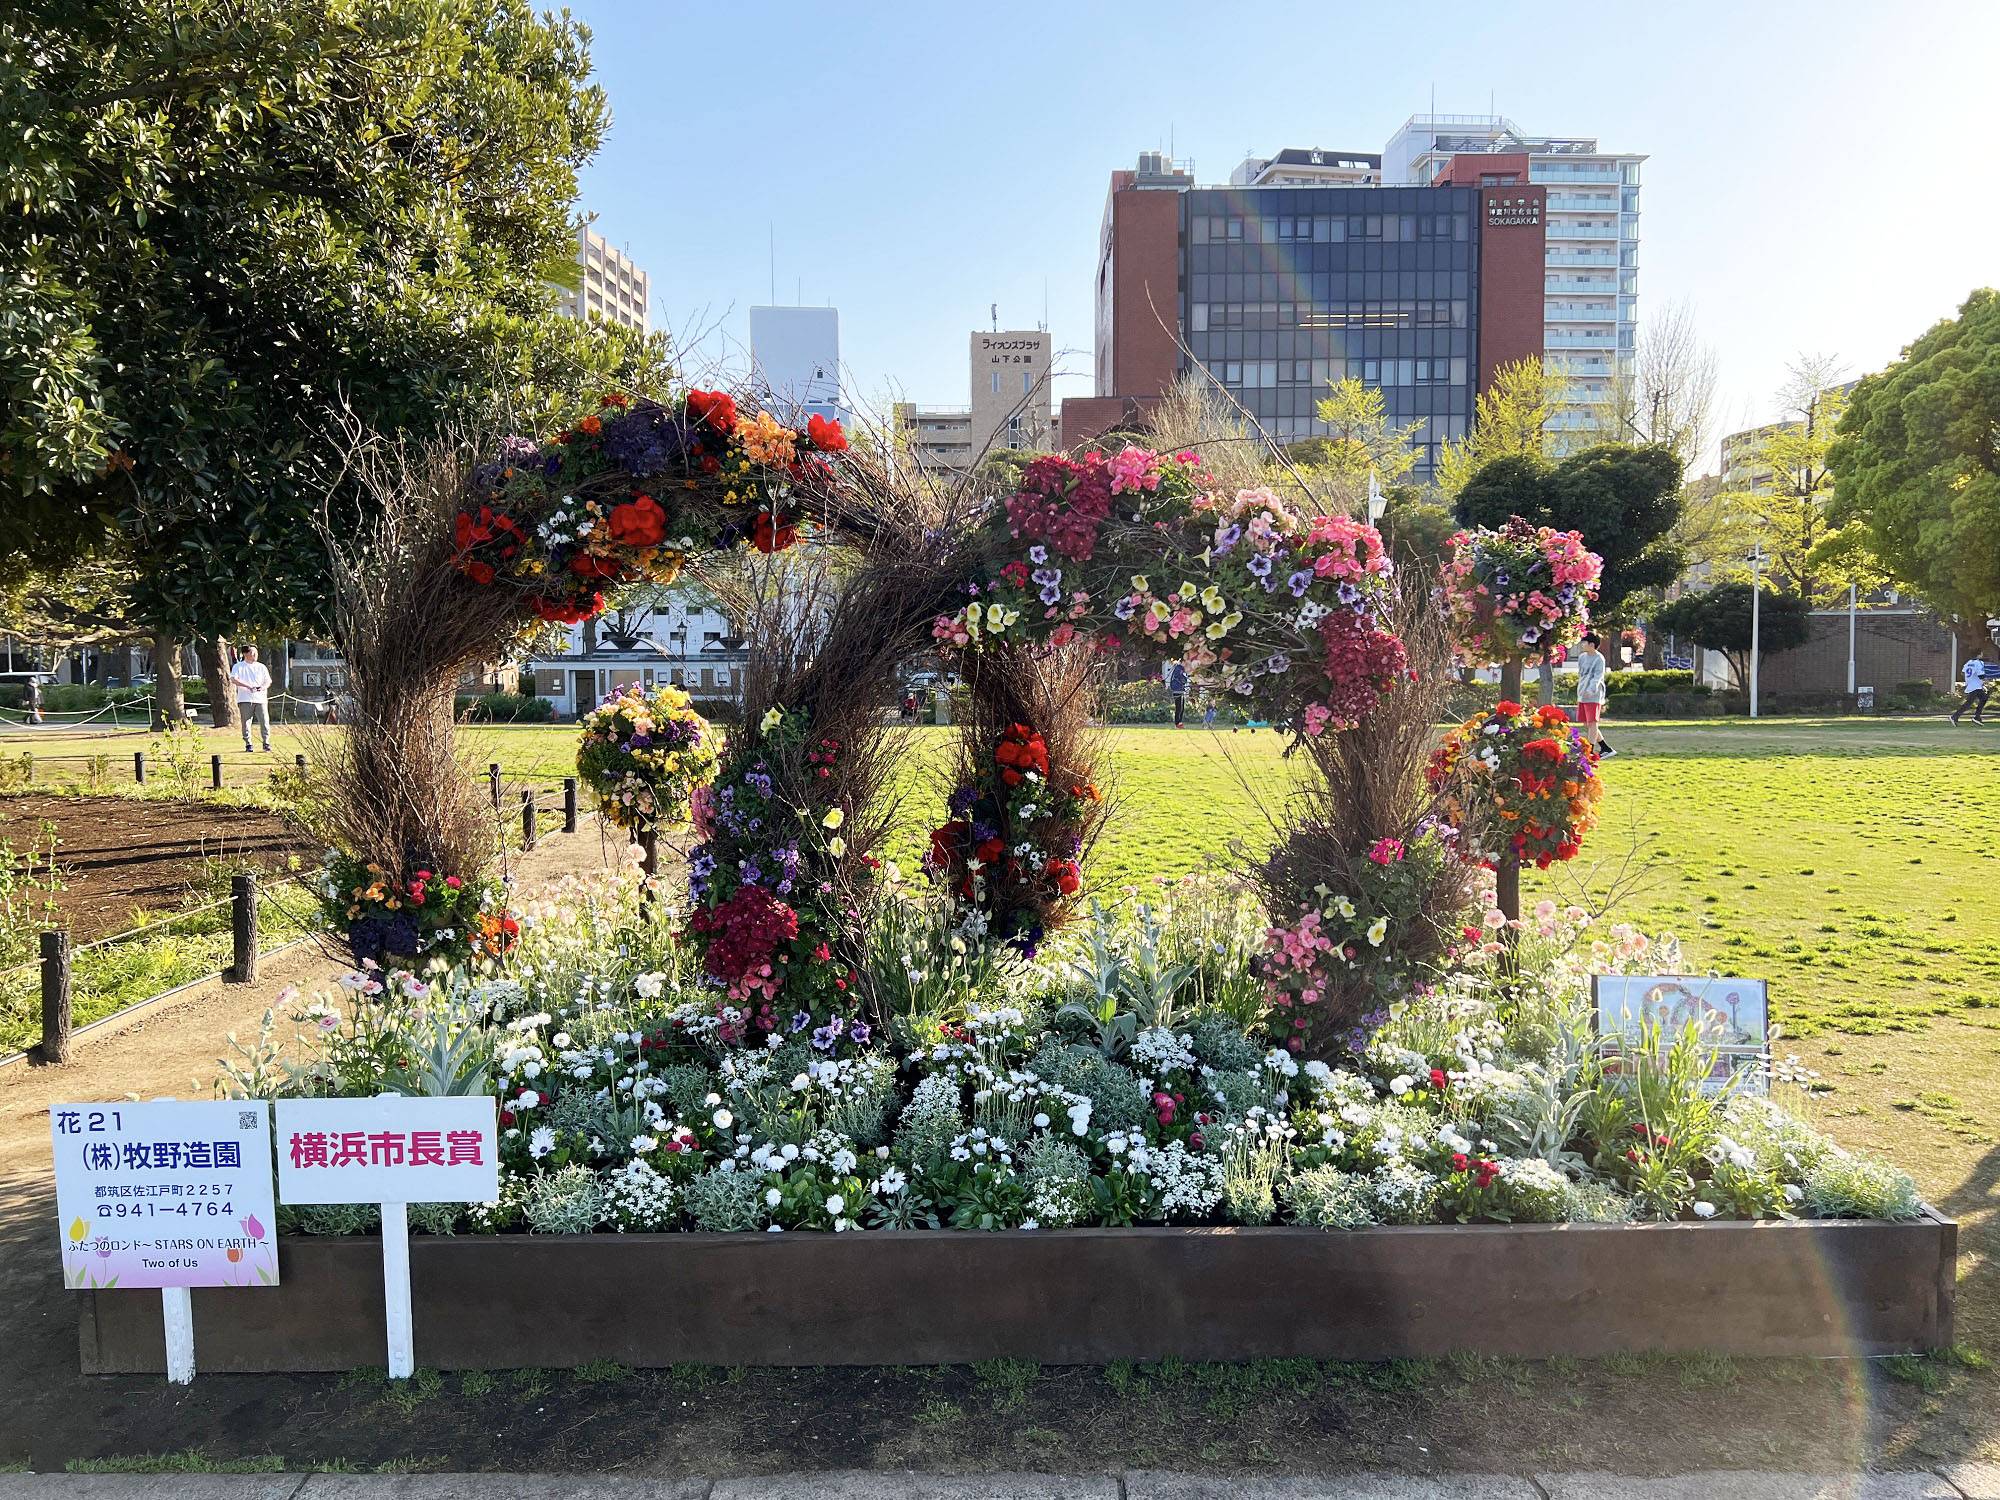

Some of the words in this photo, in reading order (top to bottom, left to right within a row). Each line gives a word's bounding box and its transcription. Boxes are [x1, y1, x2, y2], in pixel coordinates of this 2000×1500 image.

[83, 1141, 241, 1171] (株)牧野造園
[289, 1130, 484, 1168] 横浜市長賞
[155, 1239, 193, 1250] STARS
[197, 1238, 214, 1249] ON
[142, 1258, 165, 1268] Two
[168, 1258, 180, 1268] of
[183, 1258, 198, 1268] Us
